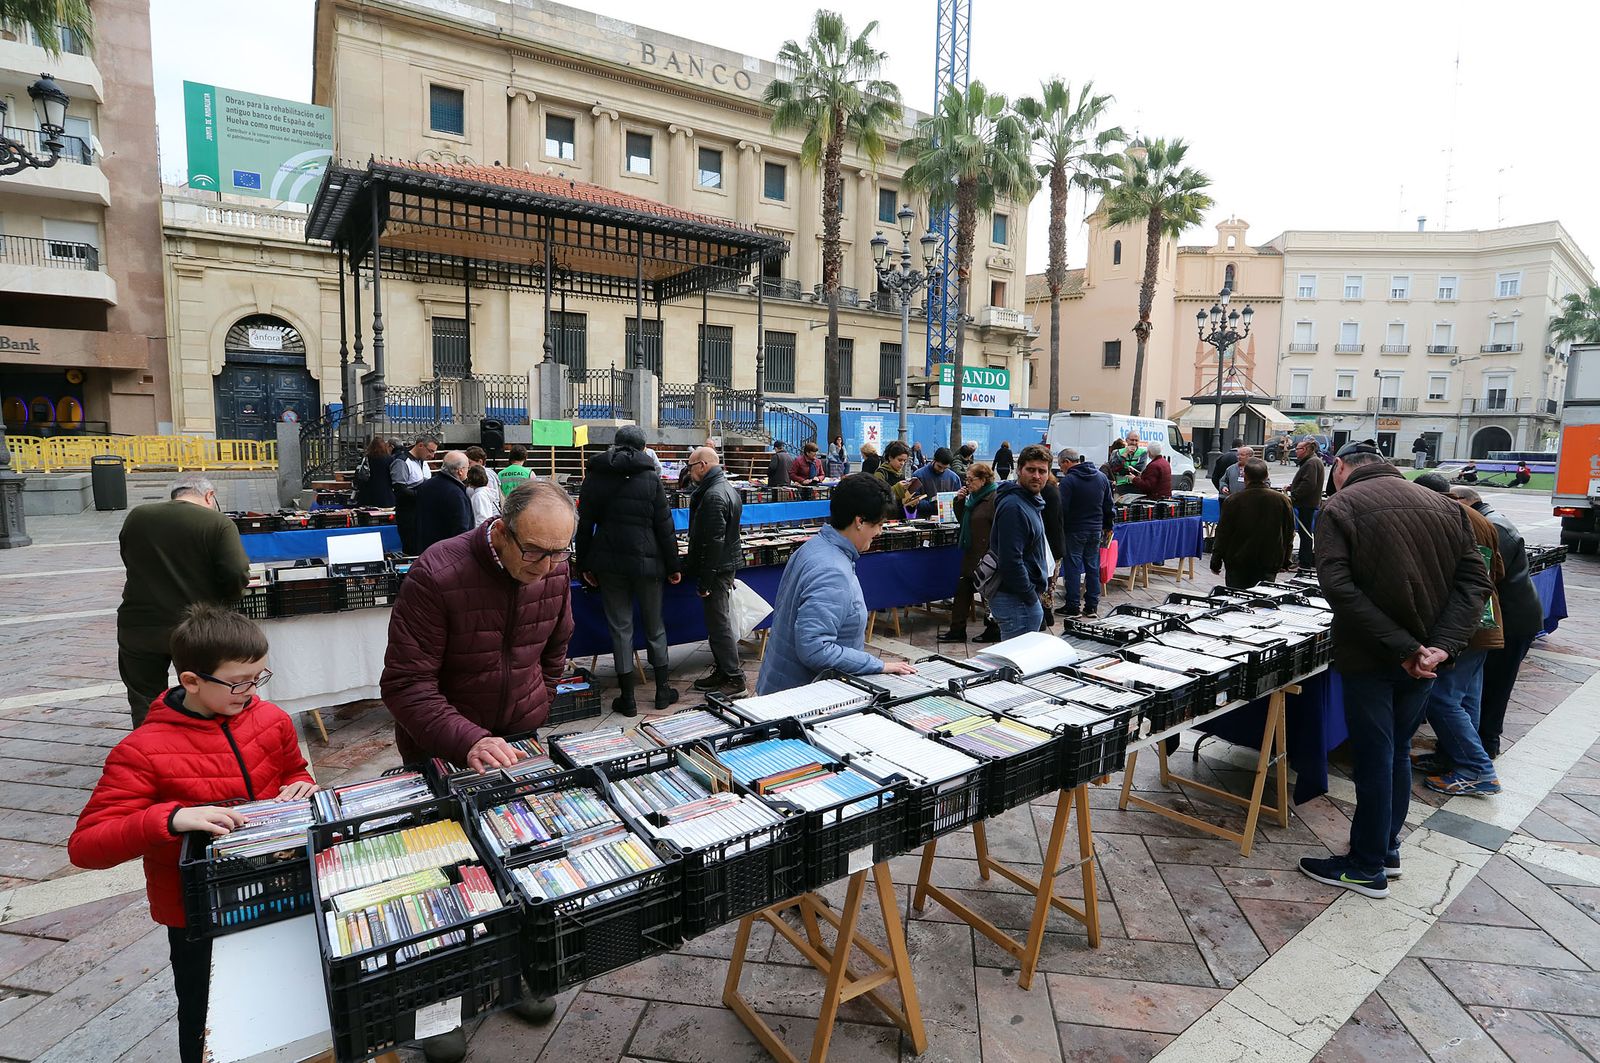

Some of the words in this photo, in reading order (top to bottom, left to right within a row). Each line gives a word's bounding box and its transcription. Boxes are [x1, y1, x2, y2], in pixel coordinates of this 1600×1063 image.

[640, 42, 750, 91] BANCO
[225, 95, 245, 106] Obras
[247, 101, 262, 109] para
[263, 103, 270, 111] la
[271, 105, 314, 118] rehabilitación
[315, 113, 325, 121] del
[225, 107, 251, 117] antiguo
[252, 110, 272, 121] banco
[283, 115, 306, 126] España
[307, 120, 315, 128] de
[226, 115, 249, 126] Huelva
[250, 121, 269, 129] como
[269, 124, 291, 133] museo
[291, 129, 332, 141] arqueológico
[0, 336, 40, 351] Bank
[961, 393, 996, 403] ONACON
